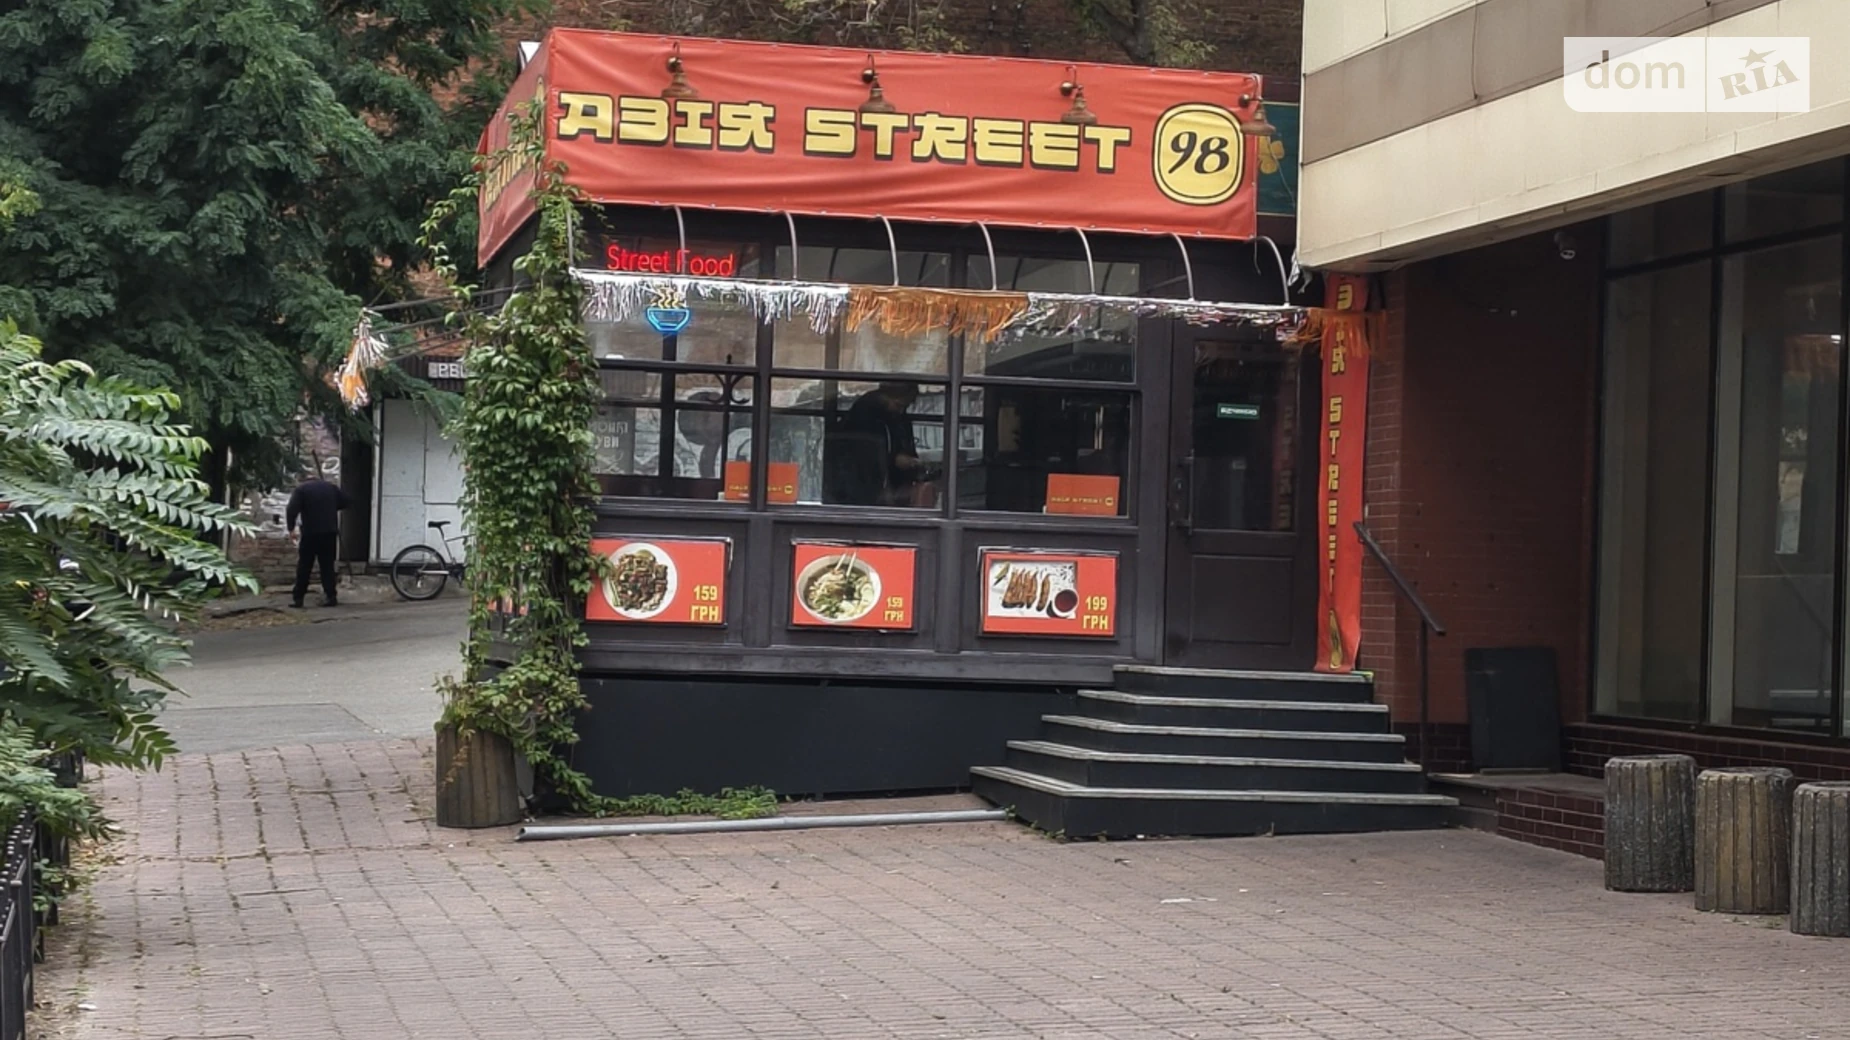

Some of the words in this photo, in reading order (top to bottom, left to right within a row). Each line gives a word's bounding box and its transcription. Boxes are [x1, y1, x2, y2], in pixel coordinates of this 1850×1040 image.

[803, 104, 1132, 174] STREET
[1166, 130, 1231, 175] 98
[606, 244, 670, 273] Street
[675, 248, 734, 276] Food
[692, 584, 718, 601] 159
[886, 596, 904, 609] 159
[1085, 596, 1108, 610] 199
[690, 604, 719, 622] ГРН
[884, 610, 905, 622] ГРН
[1083, 614, 1109, 630] ГРН
